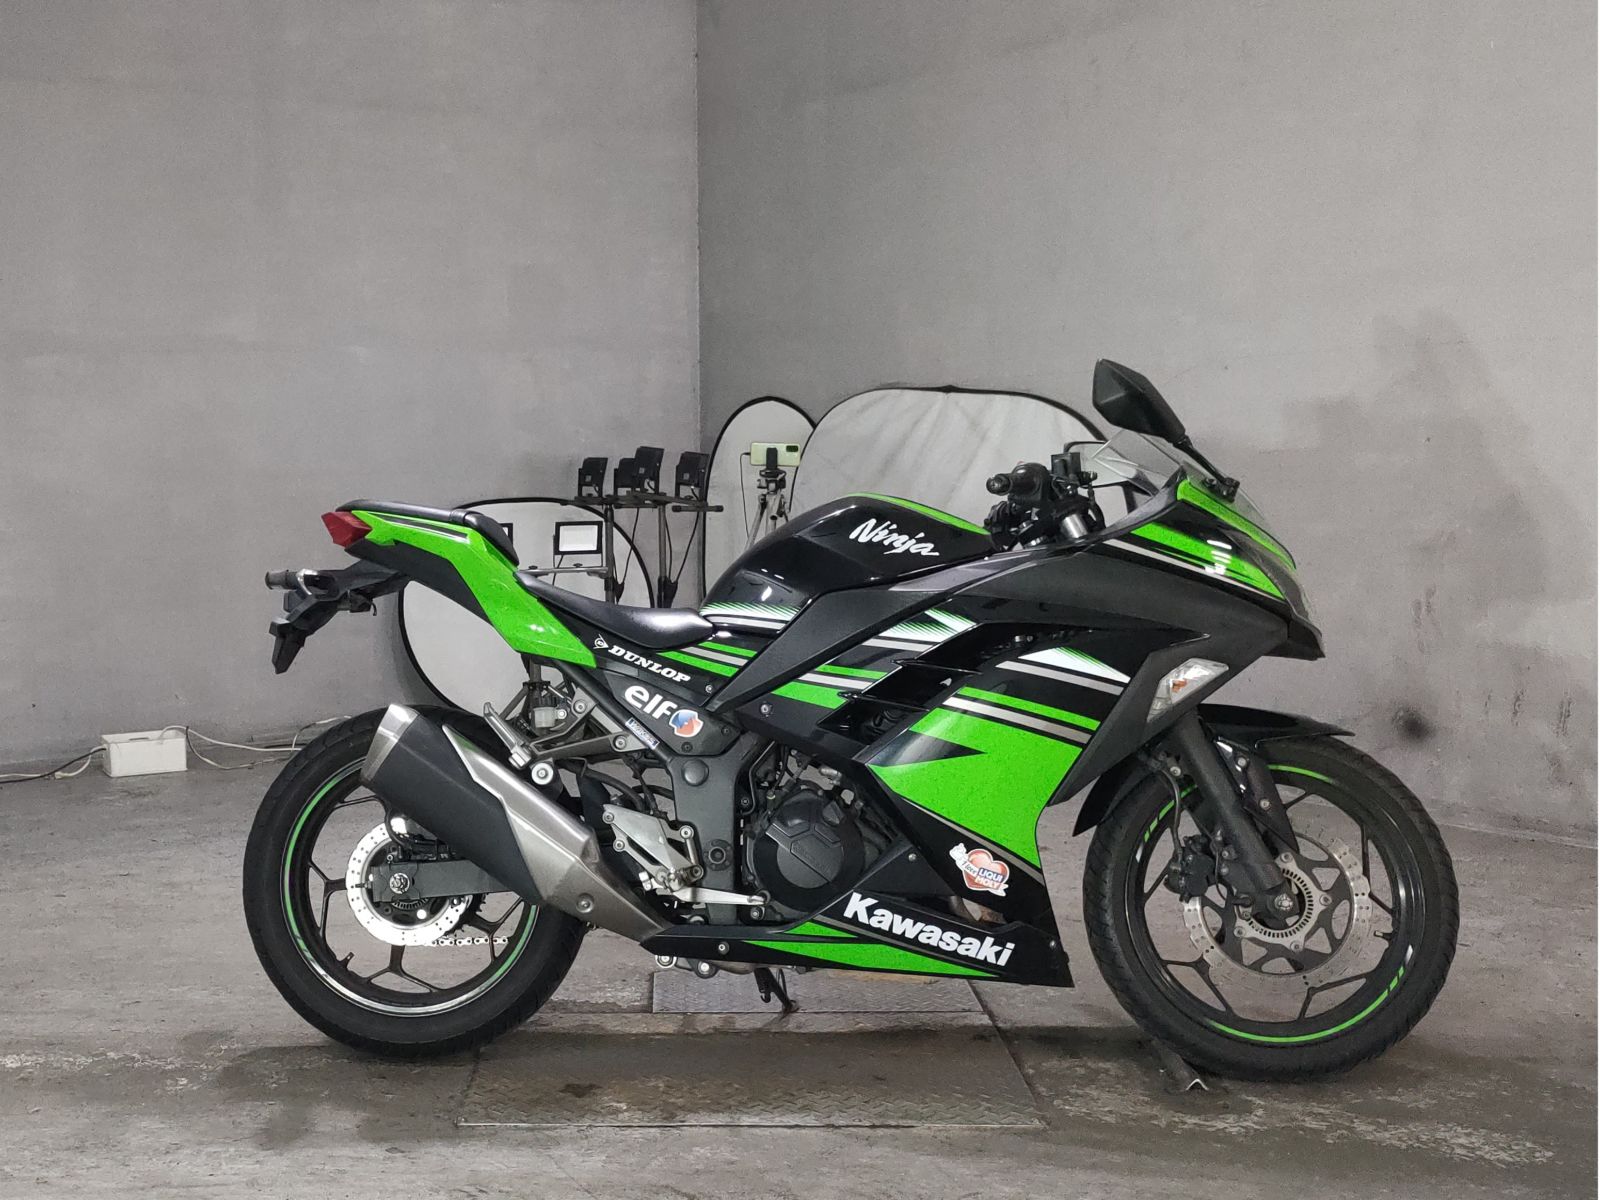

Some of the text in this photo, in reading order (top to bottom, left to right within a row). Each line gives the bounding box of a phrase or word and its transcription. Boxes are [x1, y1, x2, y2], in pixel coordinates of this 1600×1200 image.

[849, 518, 940, 556] Ninja
[608, 645, 691, 682] DUNLOP
[624, 685, 678, 719] elf
[974, 876, 1000, 889] MOLY
[978, 868, 1003, 883] LIQUI
[843, 892, 1015, 966] Kawasaki
